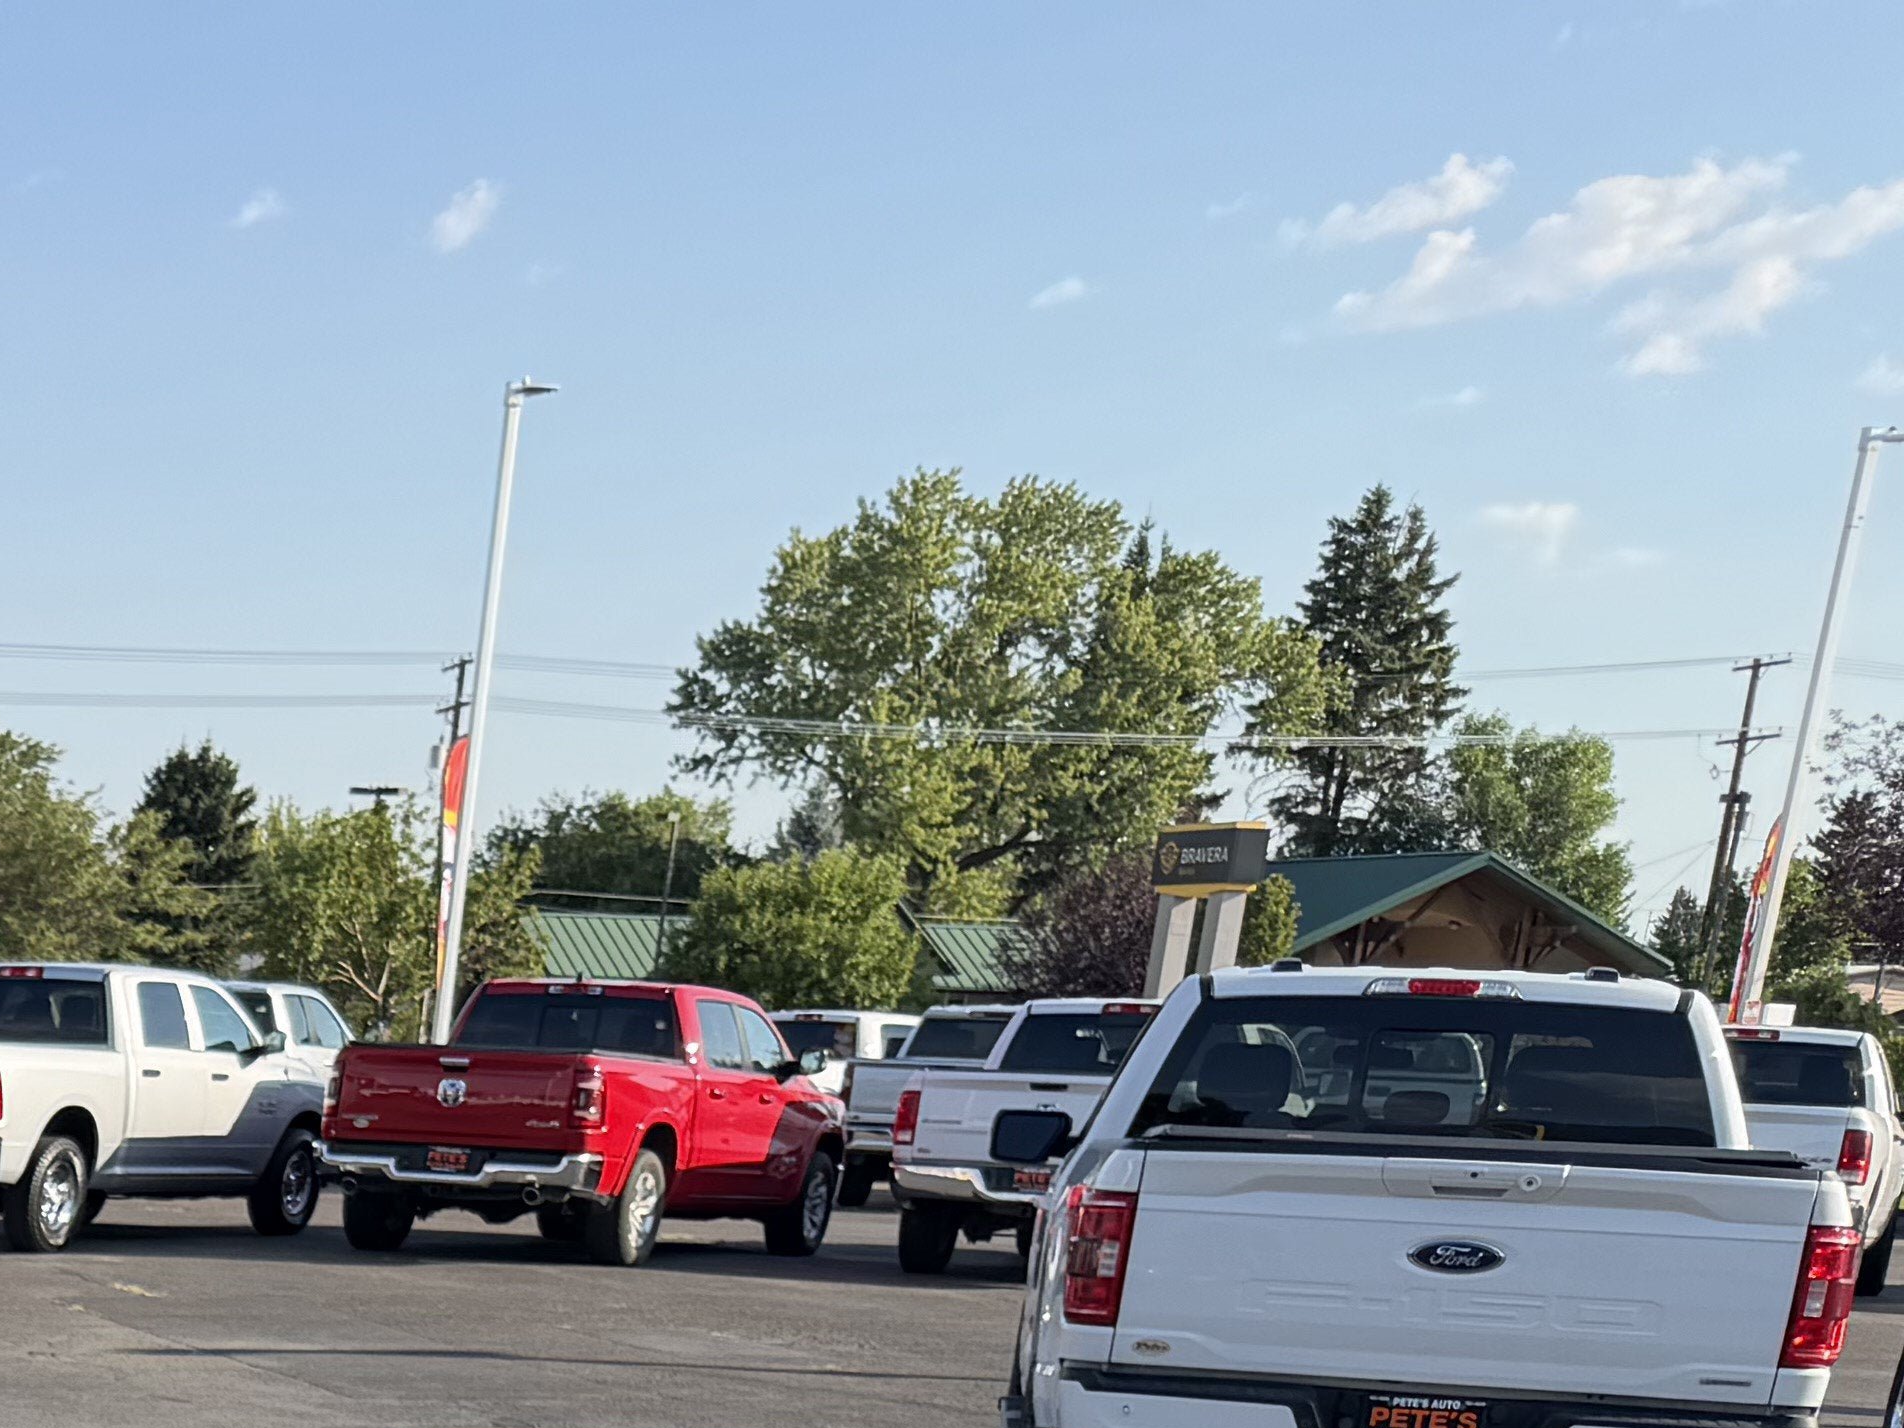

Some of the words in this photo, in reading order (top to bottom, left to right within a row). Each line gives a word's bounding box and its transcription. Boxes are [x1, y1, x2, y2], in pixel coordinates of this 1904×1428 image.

[1181, 846, 1229, 864] BRAVERA
[1429, 1245, 1483, 1268] Ford
[1392, 1396, 1430, 1408] PETE'S
[1430, 1399, 1461, 1410] AUTO
